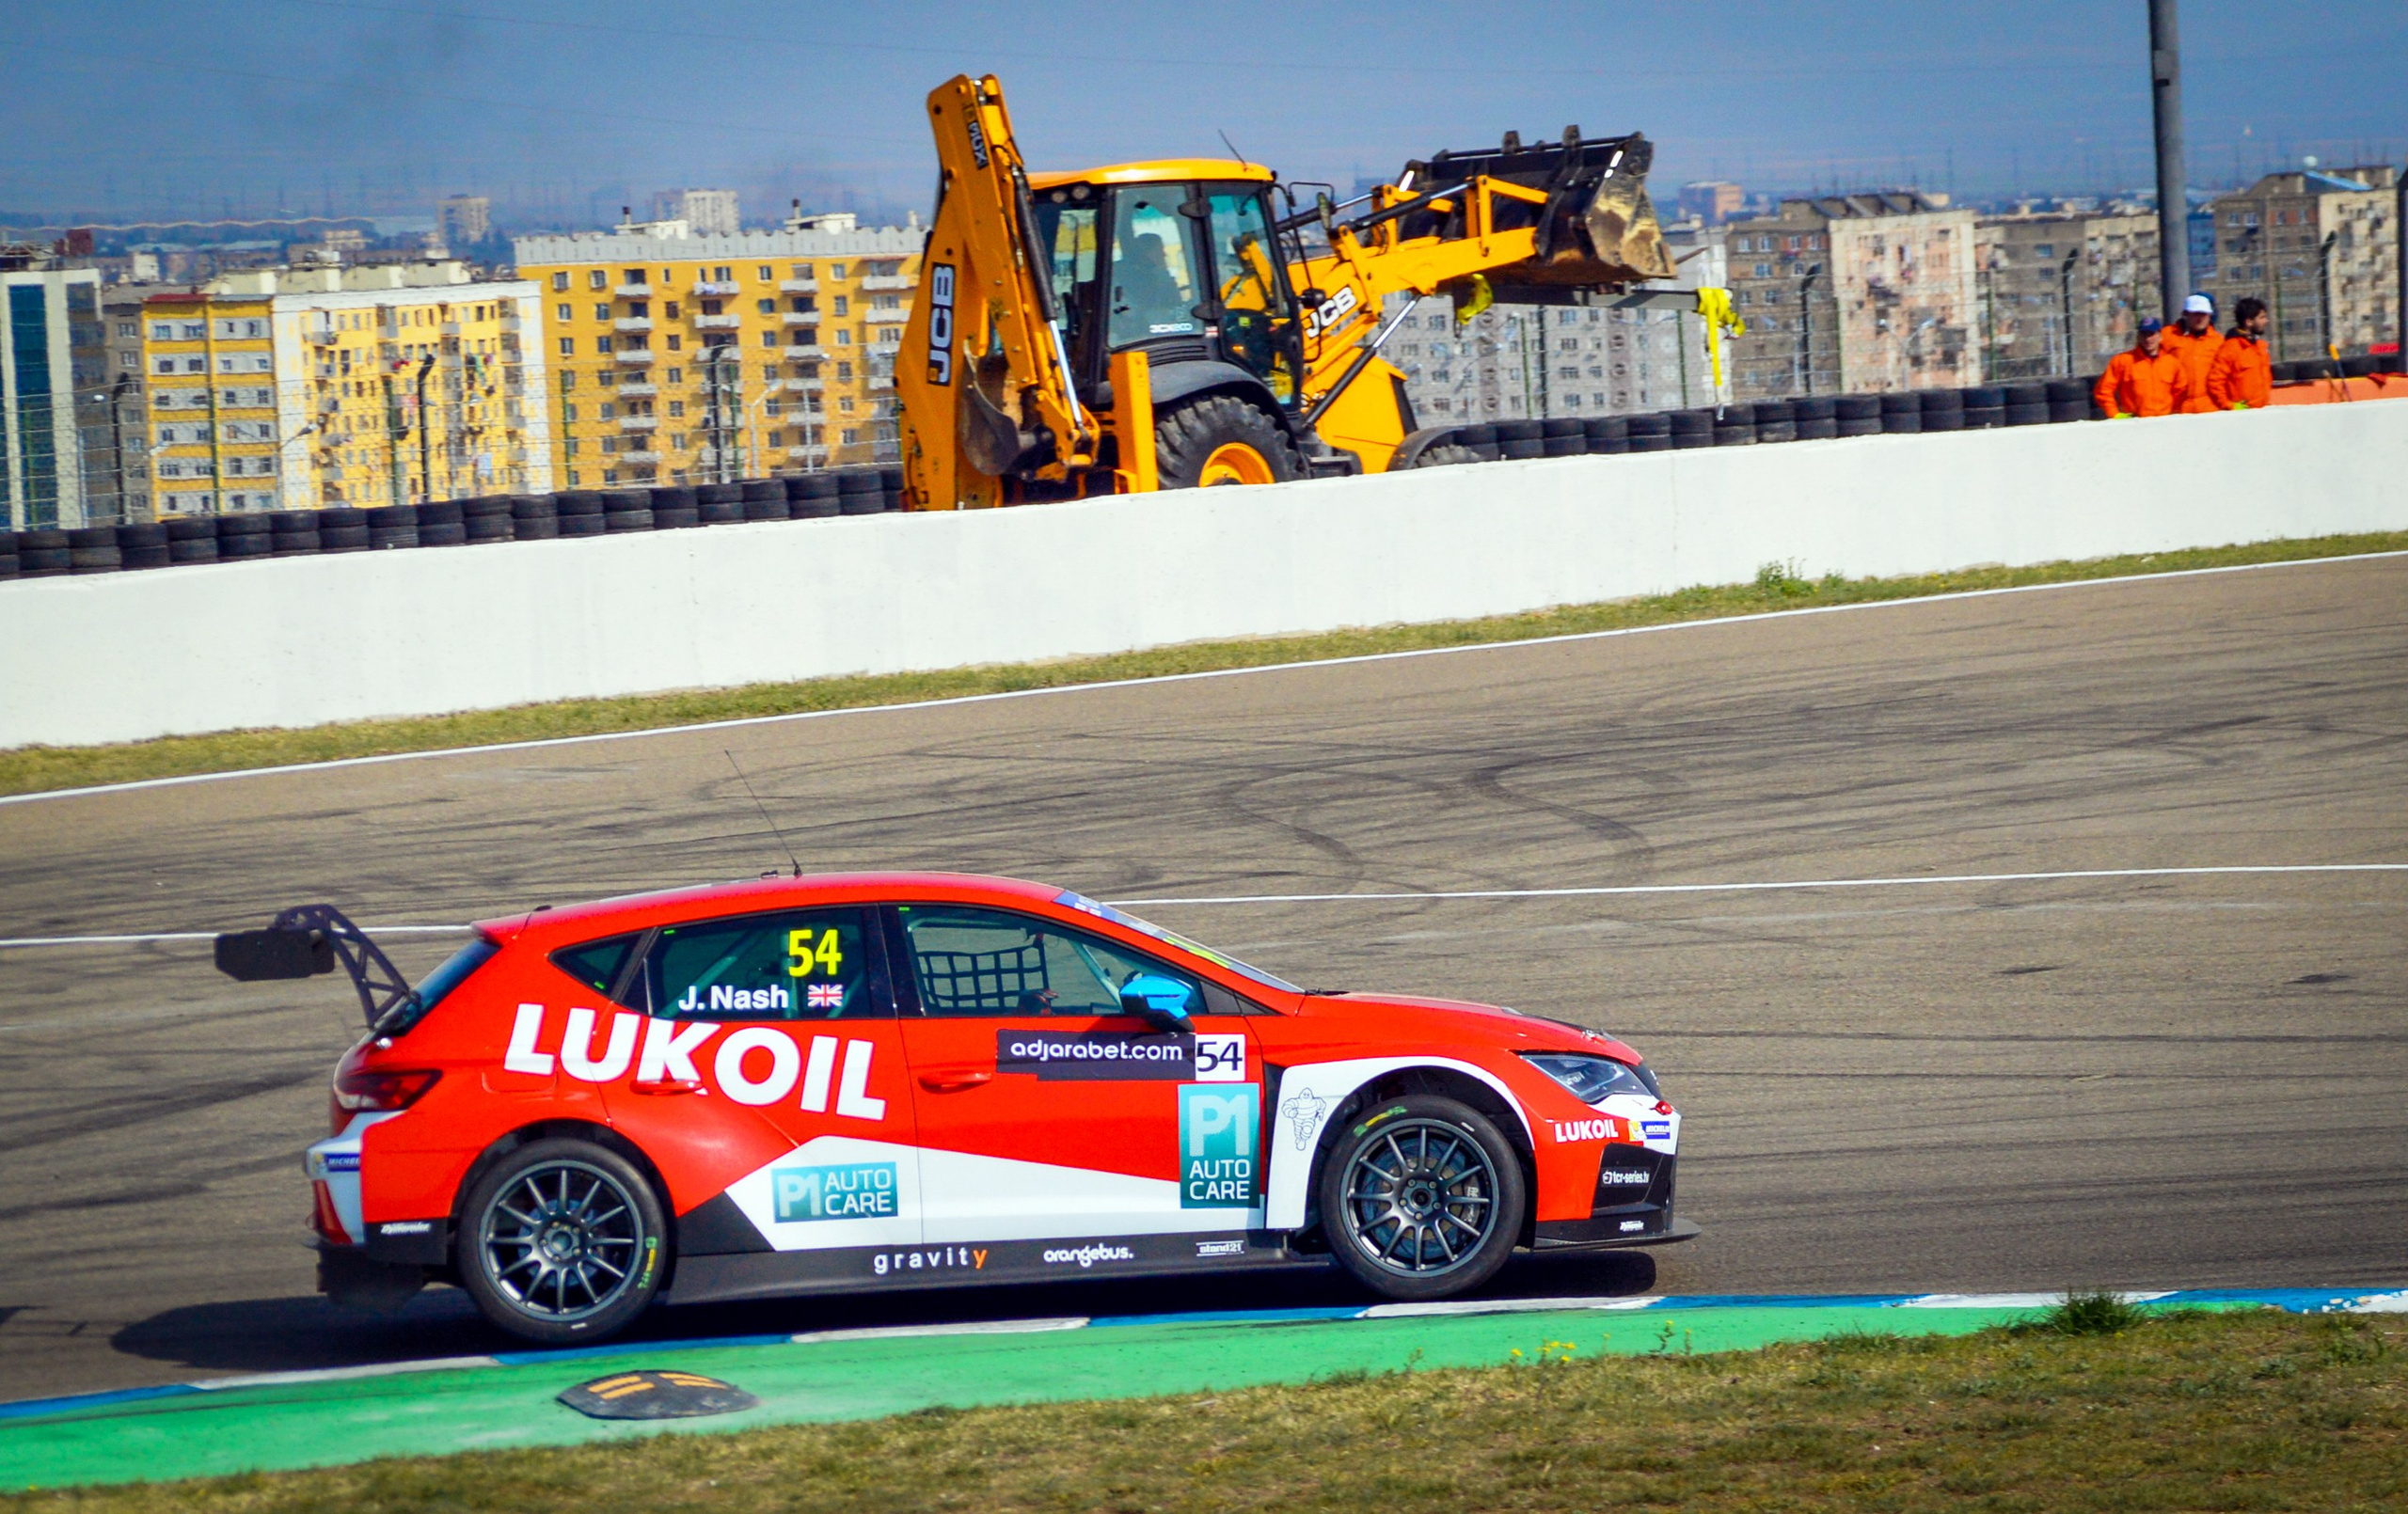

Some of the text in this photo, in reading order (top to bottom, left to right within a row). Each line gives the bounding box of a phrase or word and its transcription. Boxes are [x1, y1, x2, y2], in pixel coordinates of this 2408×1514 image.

[930, 266, 954, 383] JCB
[1306, 286, 1356, 338] JCB
[788, 929, 842, 976] 54
[678, 985, 788, 1011] J. Nash
[503, 1002, 886, 1121] LUKOIL
[1010, 1039, 1183, 1062] adjarabet.com
[1196, 1041, 1243, 1072] 54
[1189, 1094, 1249, 1157] P1
[1555, 1119, 1619, 1143] LUKOIL
[825, 1169, 892, 1192] AUTO
[1189, 1159, 1250, 1179] AUTO
[777, 1173, 821, 1217] P1
[825, 1191, 893, 1215] CARE
[1190, 1181, 1250, 1200] CARE
[873, 1247, 987, 1275] gravity
